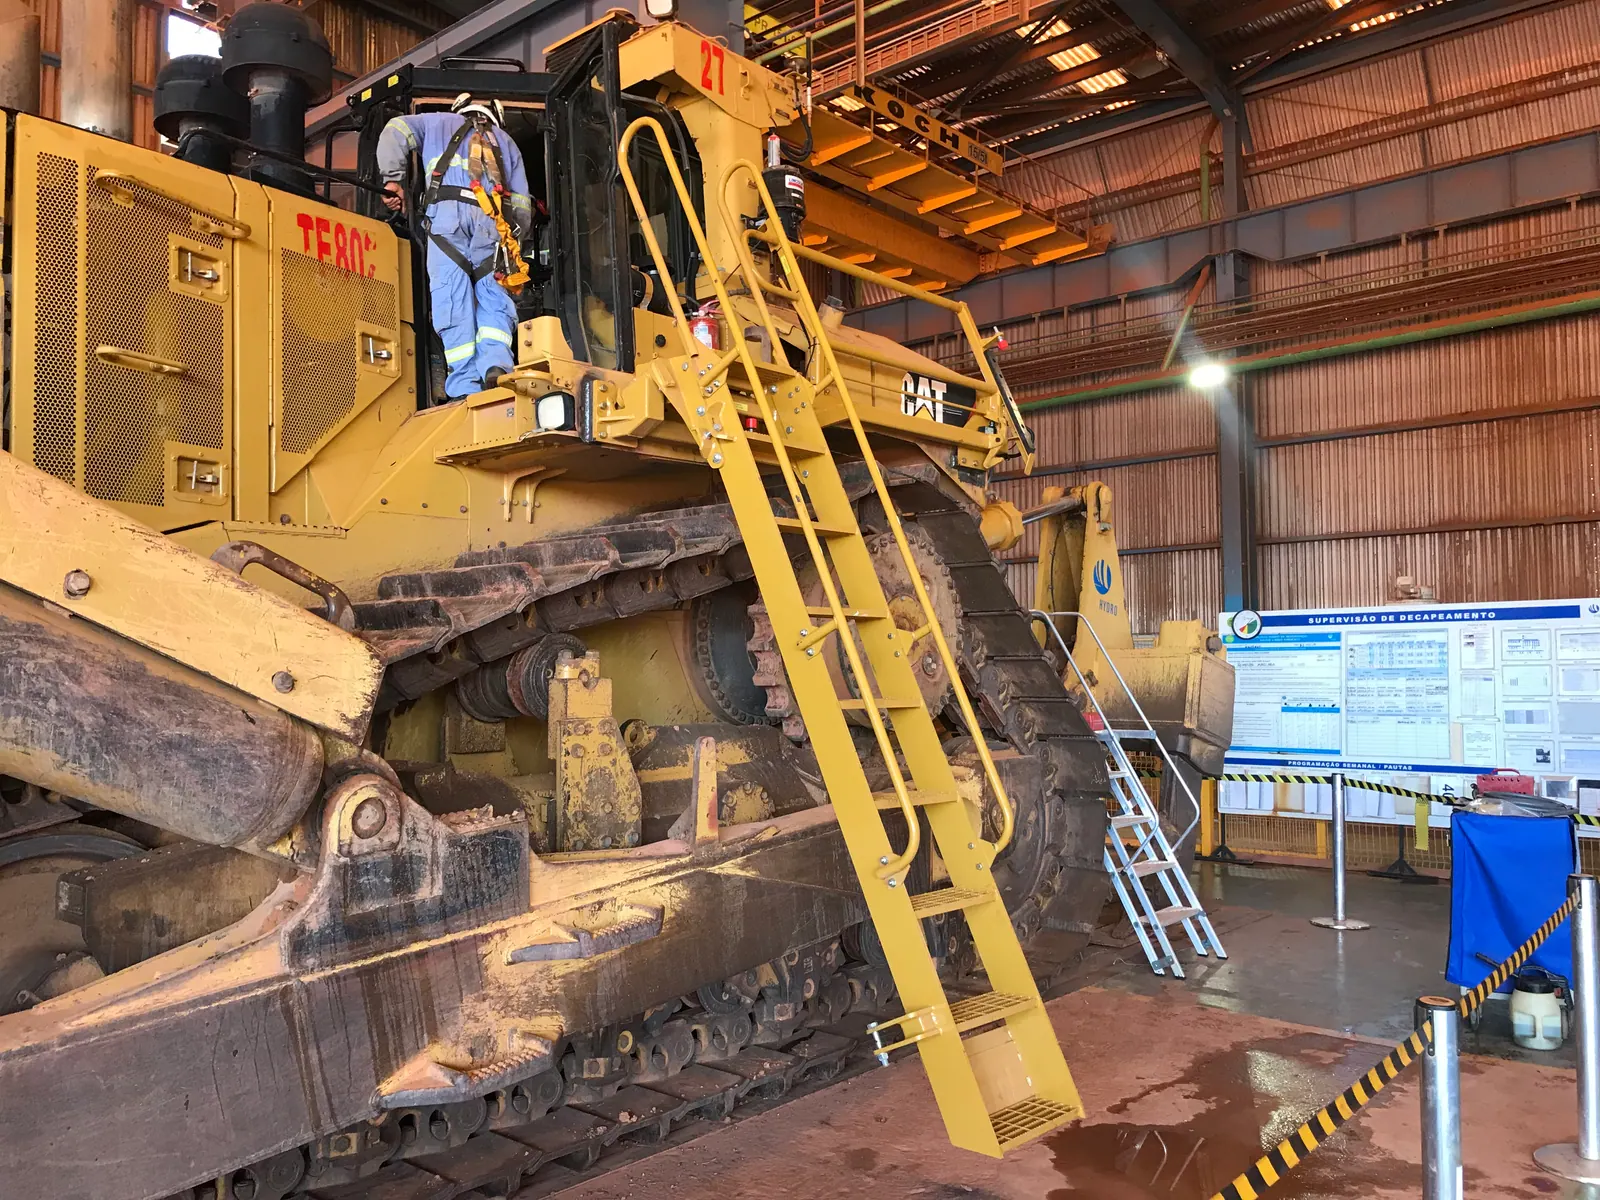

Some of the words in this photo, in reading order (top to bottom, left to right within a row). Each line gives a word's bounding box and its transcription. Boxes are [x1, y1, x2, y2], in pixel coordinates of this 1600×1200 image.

[700, 39, 725, 96] 27
[853, 84, 960, 150] KOCH
[900, 372, 947, 423] CAT
[1099, 599, 1118, 616] HYDRO
[1308, 615, 1376, 624] SUPERVISÃO
[1399, 612, 1496, 621] DECAPEAMENTO
[1288, 760, 1340, 768] PROGRAMAÇÃO
